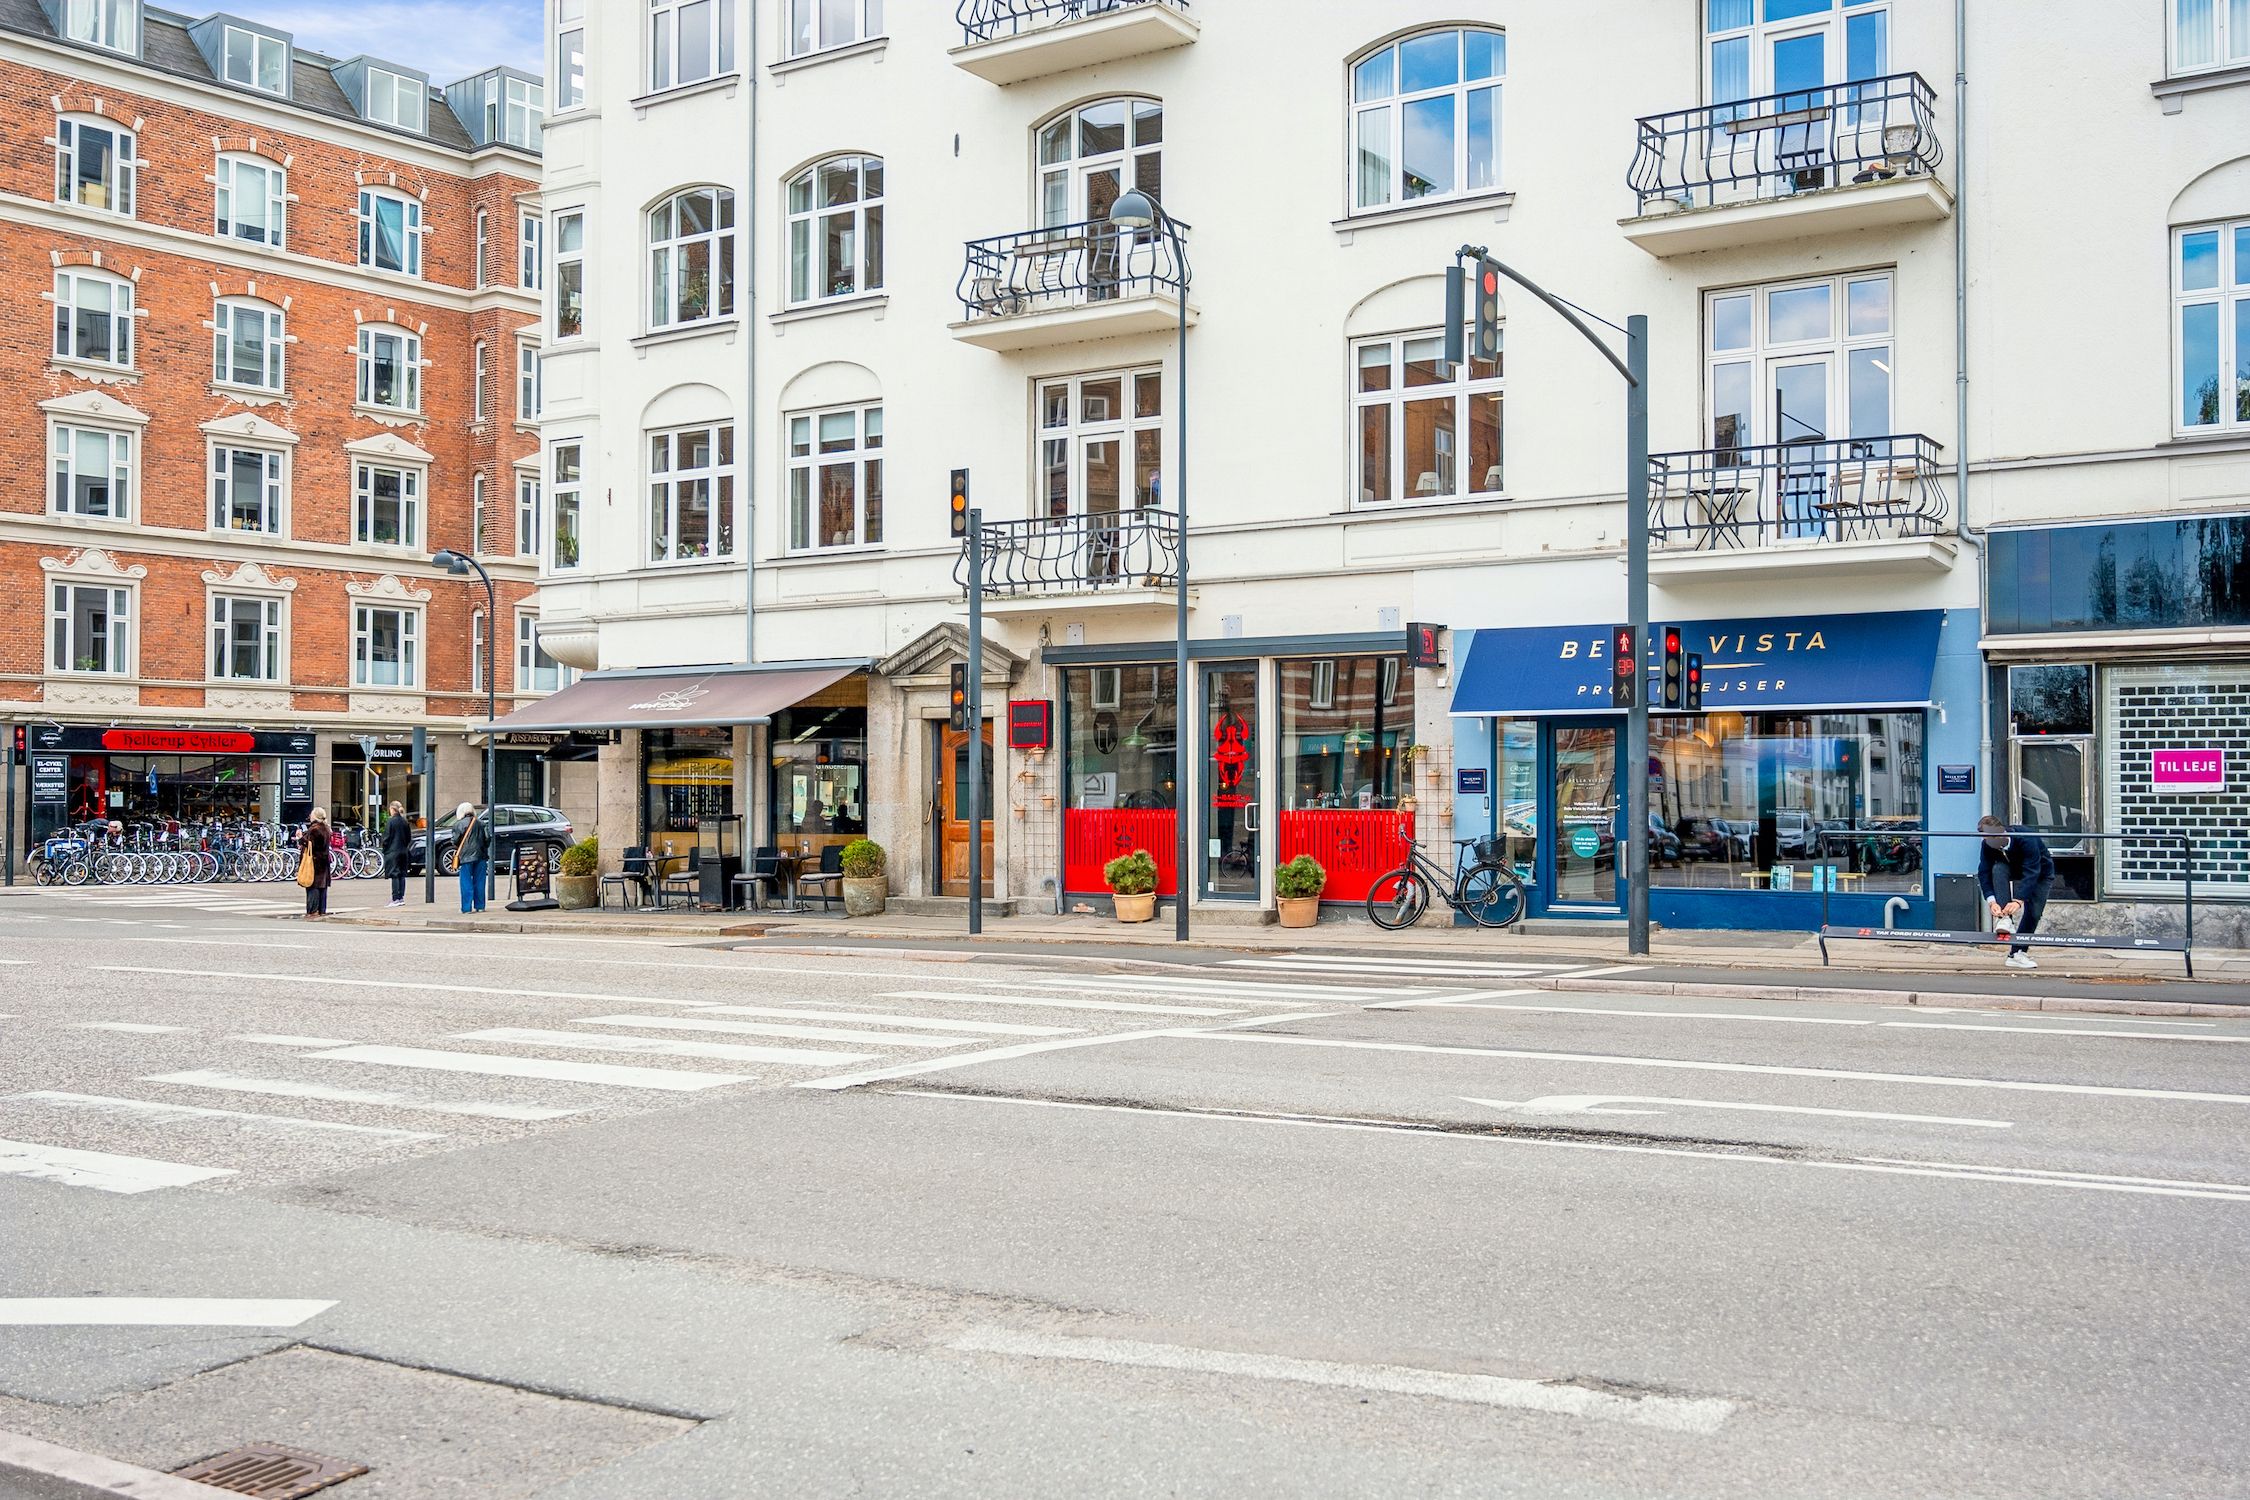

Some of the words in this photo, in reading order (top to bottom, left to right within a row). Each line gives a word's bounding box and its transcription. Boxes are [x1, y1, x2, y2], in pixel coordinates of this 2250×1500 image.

[1708, 631, 1826, 654] VISTA
[1618, 659, 1634, 675] 39
[190, 735, 237, 748] Cykler
[2160, 761, 2180, 772] TIL
[2183, 761, 2216, 772] LEJE
